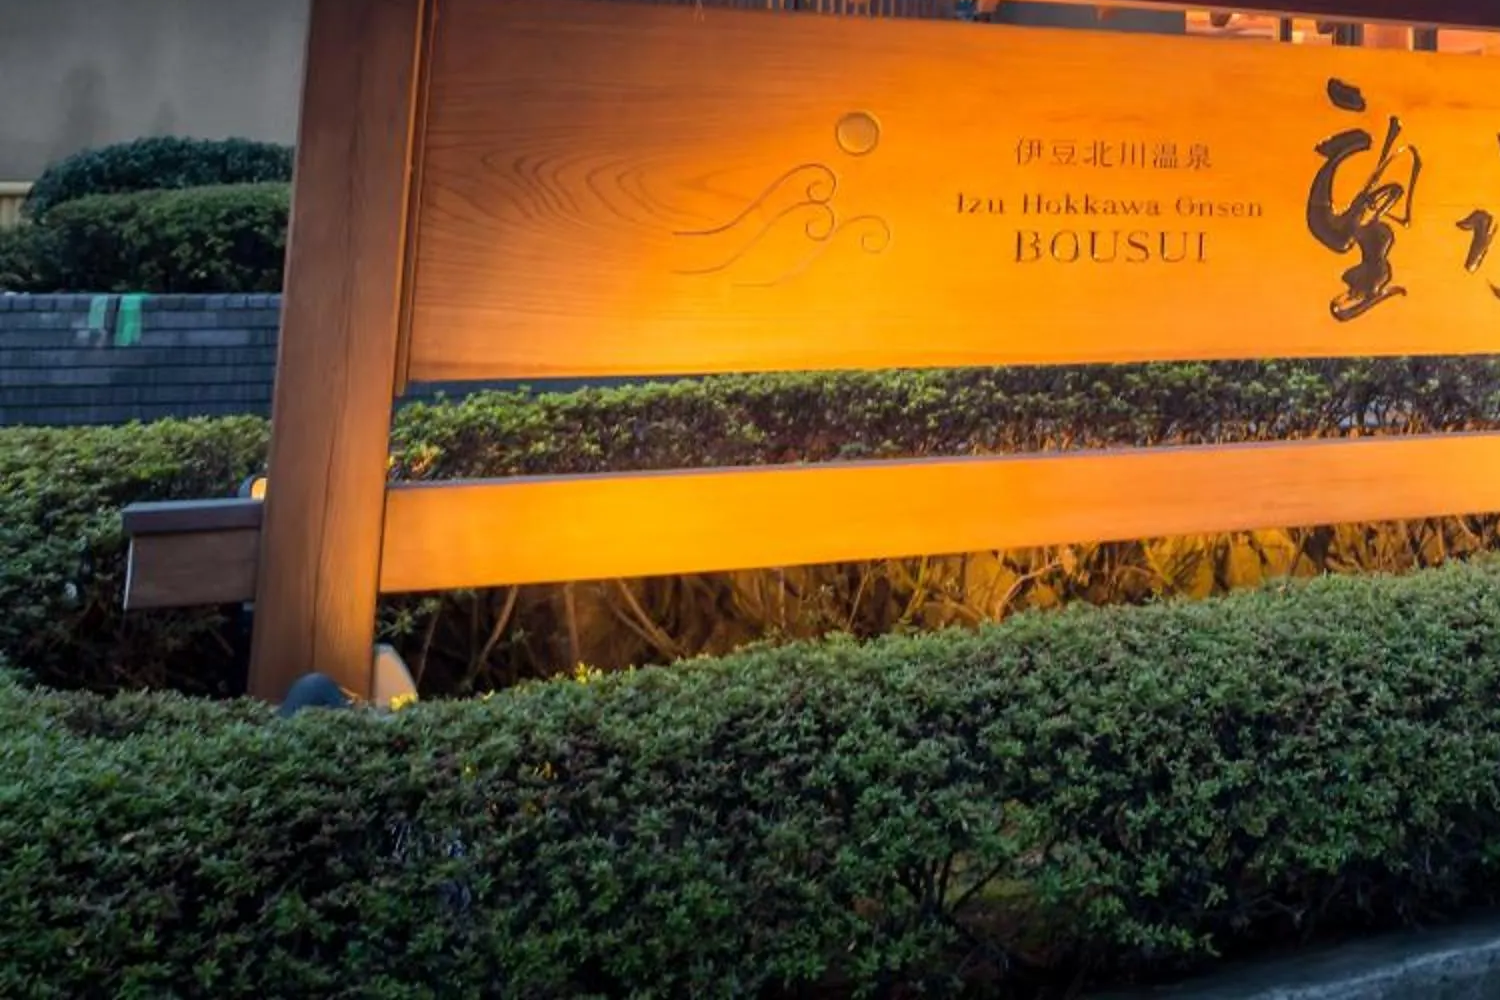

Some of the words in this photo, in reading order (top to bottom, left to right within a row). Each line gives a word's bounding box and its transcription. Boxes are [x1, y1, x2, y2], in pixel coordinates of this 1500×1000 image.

[1014, 135, 1213, 171] 伊豆北川温泉
[955, 191, 1005, 215] Izu
[1022, 192, 1162, 217] Hokkawa
[1174, 195, 1264, 218] Onsen
[1014, 229, 1207, 264] BOUSUI
